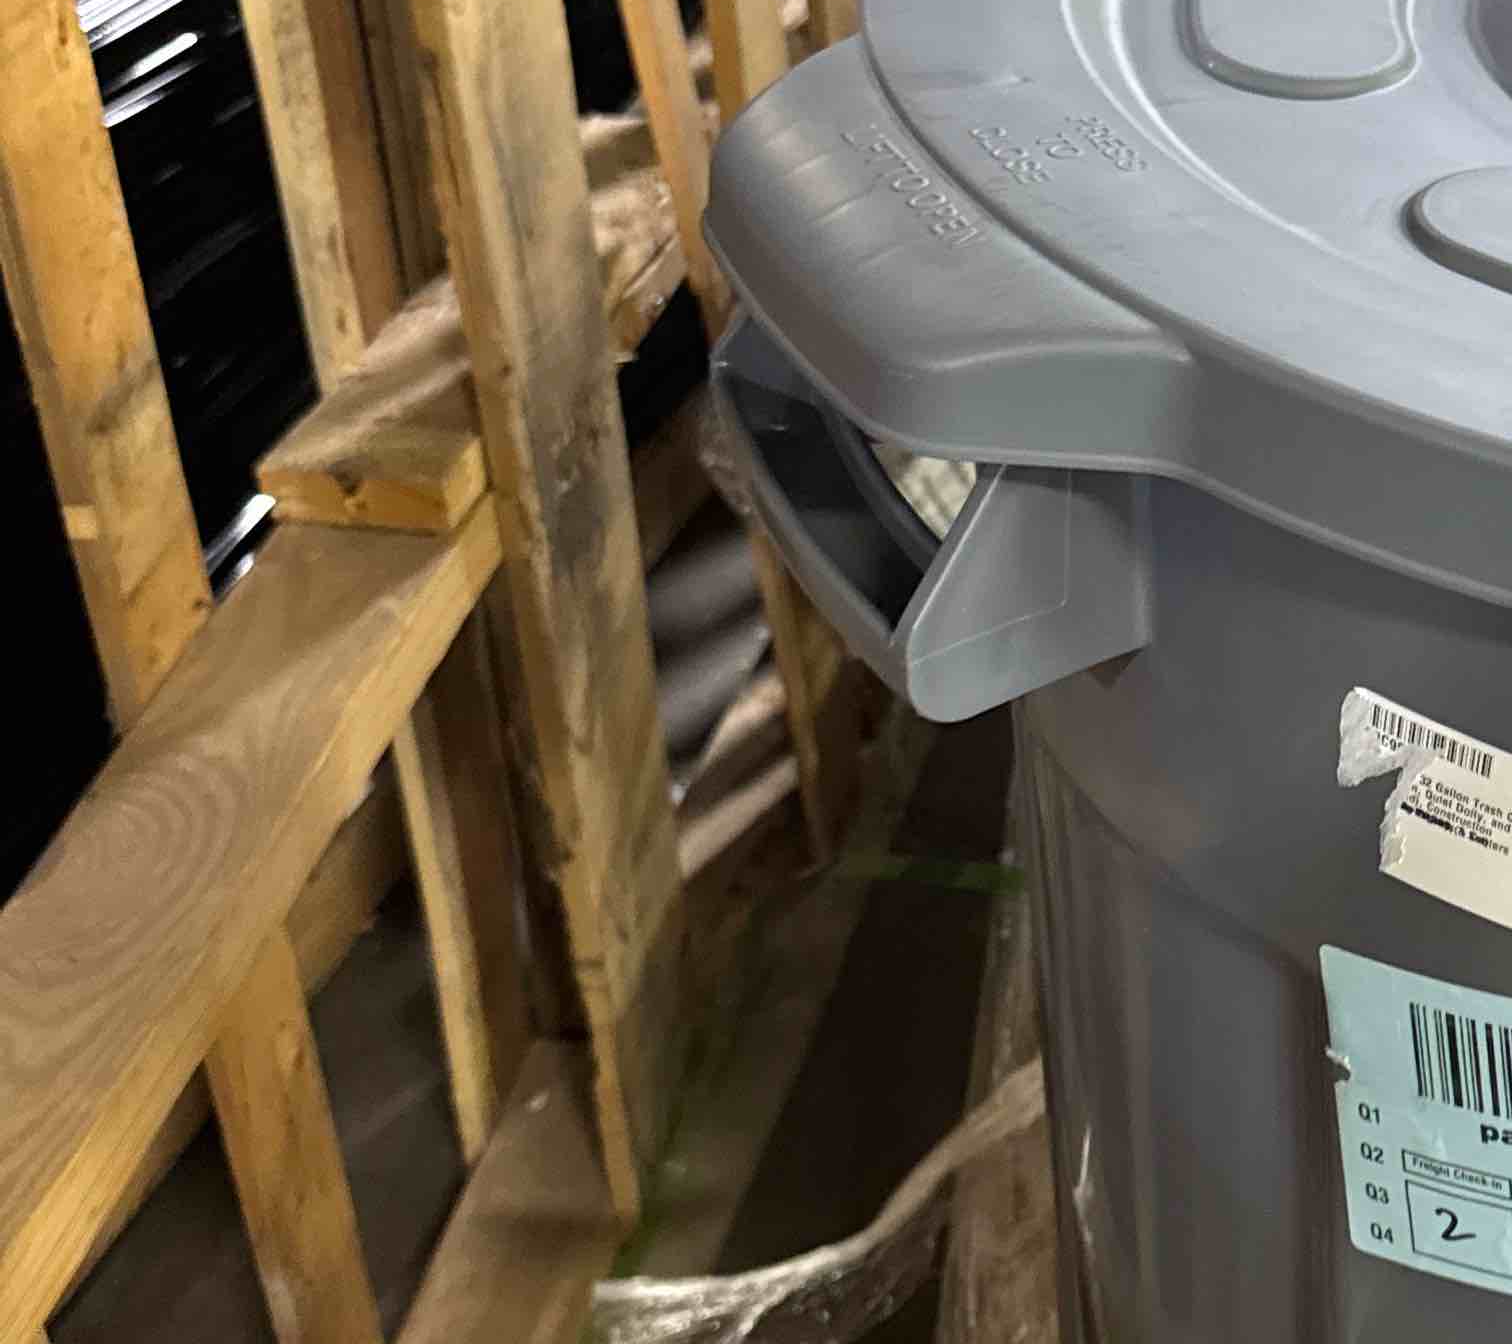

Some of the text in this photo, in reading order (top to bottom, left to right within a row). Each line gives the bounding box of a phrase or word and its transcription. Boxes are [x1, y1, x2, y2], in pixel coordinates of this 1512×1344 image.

[1435, 781, 1471, 805] Gallon
[1473, 797, 1504, 819] Trash
[1357, 1102, 1381, 1126] Q1
[1359, 1140, 1385, 1165] Q2
[1364, 1181, 1391, 1205] Q3
[1369, 1221, 1394, 1245] Q4
[1434, 1207, 1477, 1242] 2
